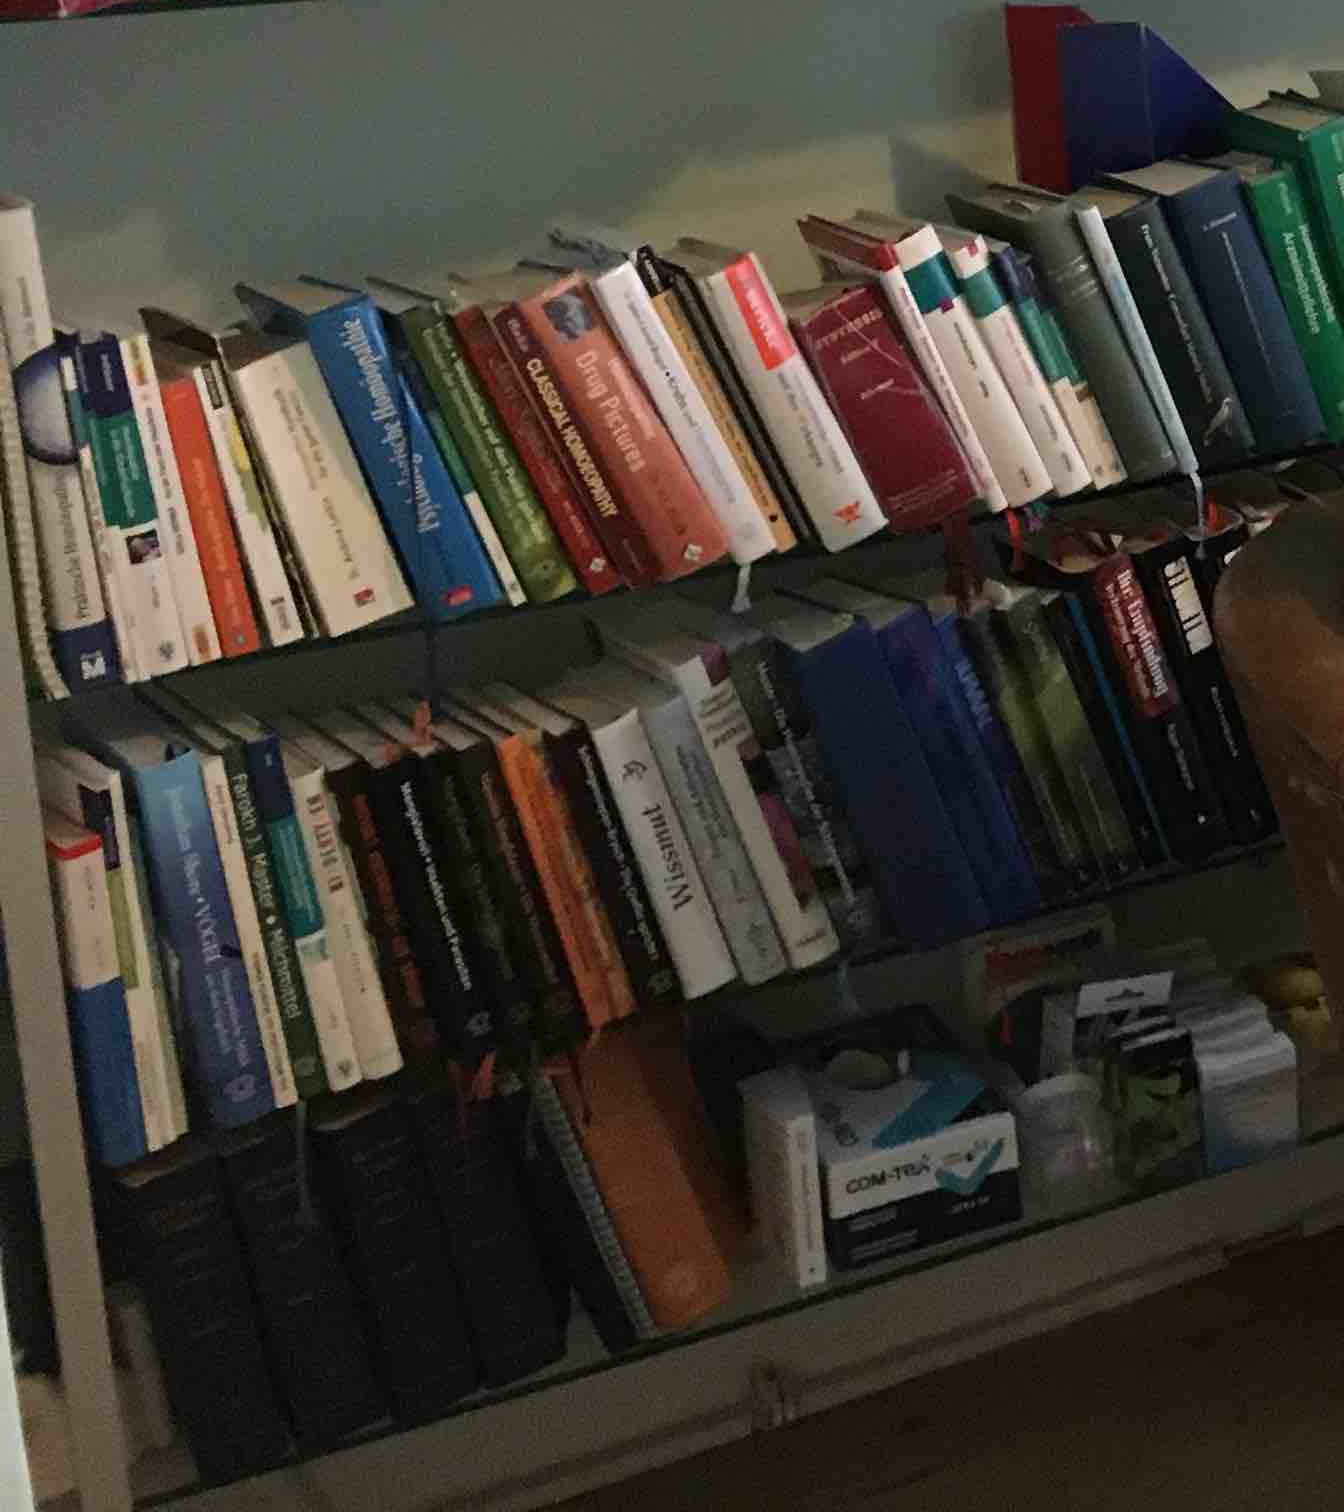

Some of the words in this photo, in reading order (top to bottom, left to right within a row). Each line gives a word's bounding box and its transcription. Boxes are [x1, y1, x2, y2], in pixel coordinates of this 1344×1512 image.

[527, 357, 570, 429] CLASSICAL
[575, 350, 609, 405] Drug
[599, 394, 647, 464] Pictures
[1127, 598, 1169, 699] Empfindung
[231, 773, 257, 834] Farokh
